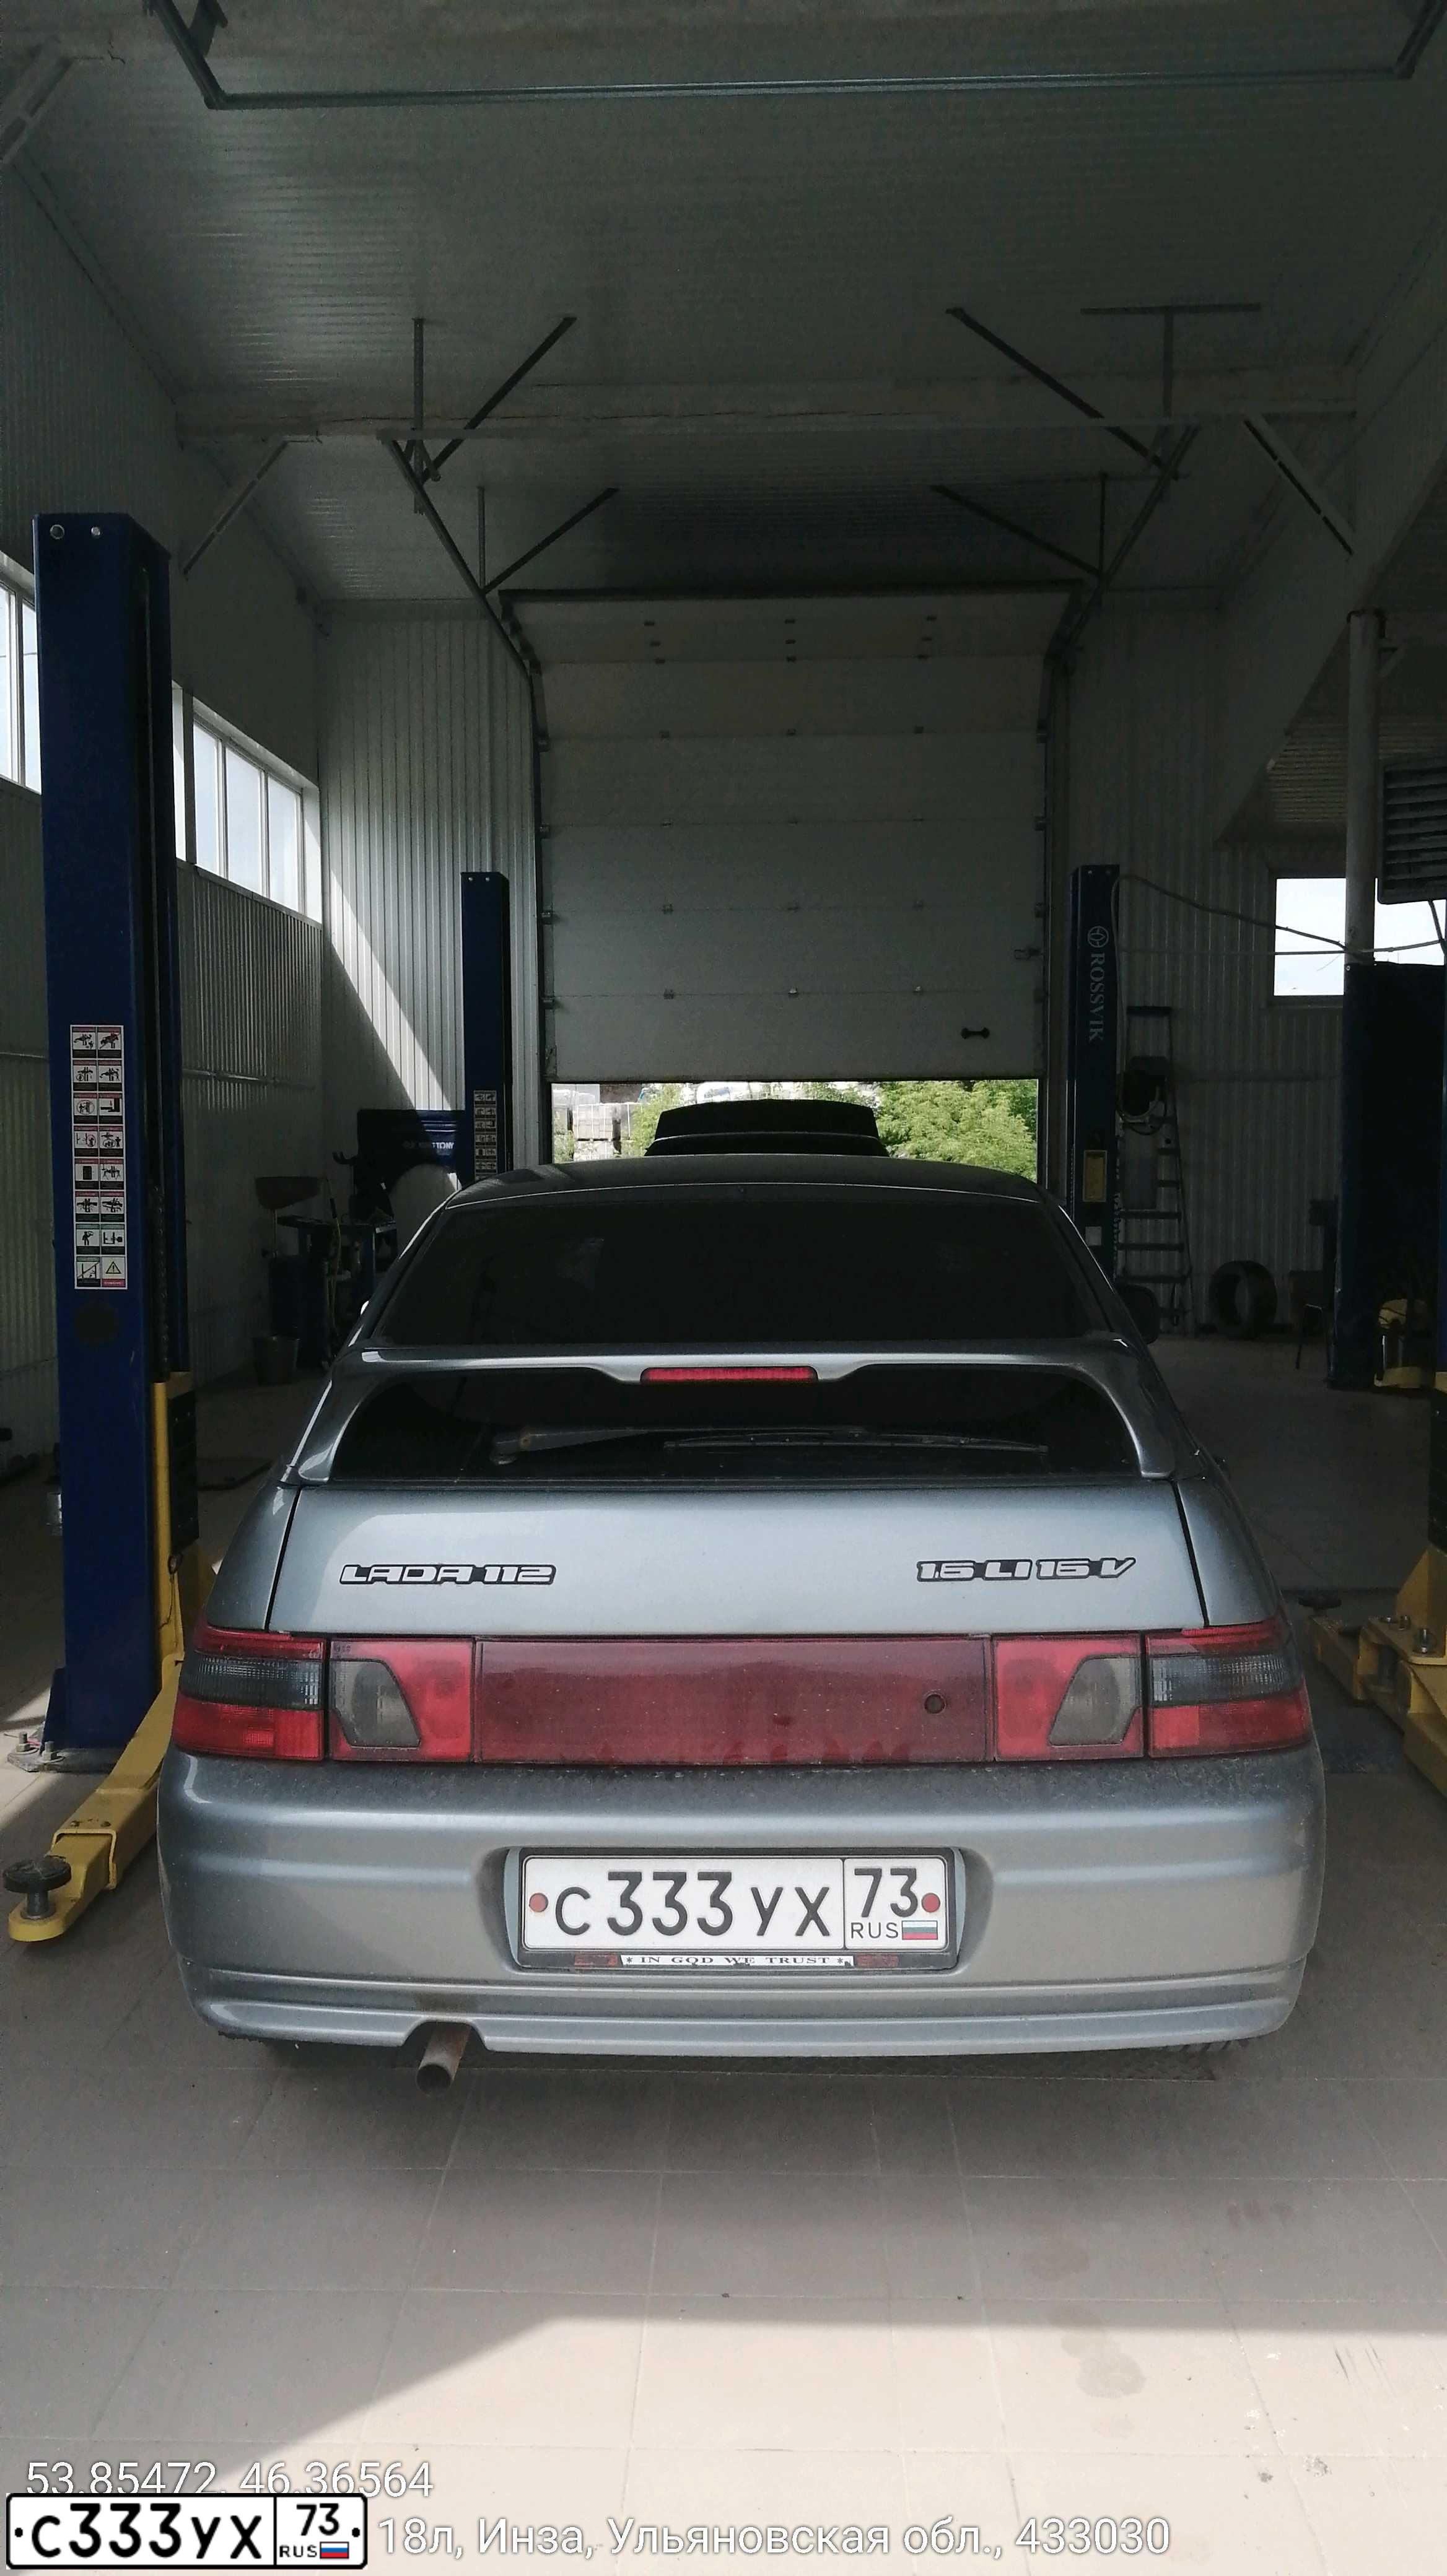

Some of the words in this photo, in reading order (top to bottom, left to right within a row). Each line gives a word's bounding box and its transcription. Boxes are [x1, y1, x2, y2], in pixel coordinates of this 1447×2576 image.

[1090, 952, 1105, 1041] ROSSVIK
[340, 1564, 475, 1584] LADA
[481, 1564, 556, 1585] 112
[854, 1868, 918, 1918] 73
[851, 1922, 899, 1939] RUS
[671, 1956, 714, 1965] GOD
[724, 1956, 755, 1965] WE
